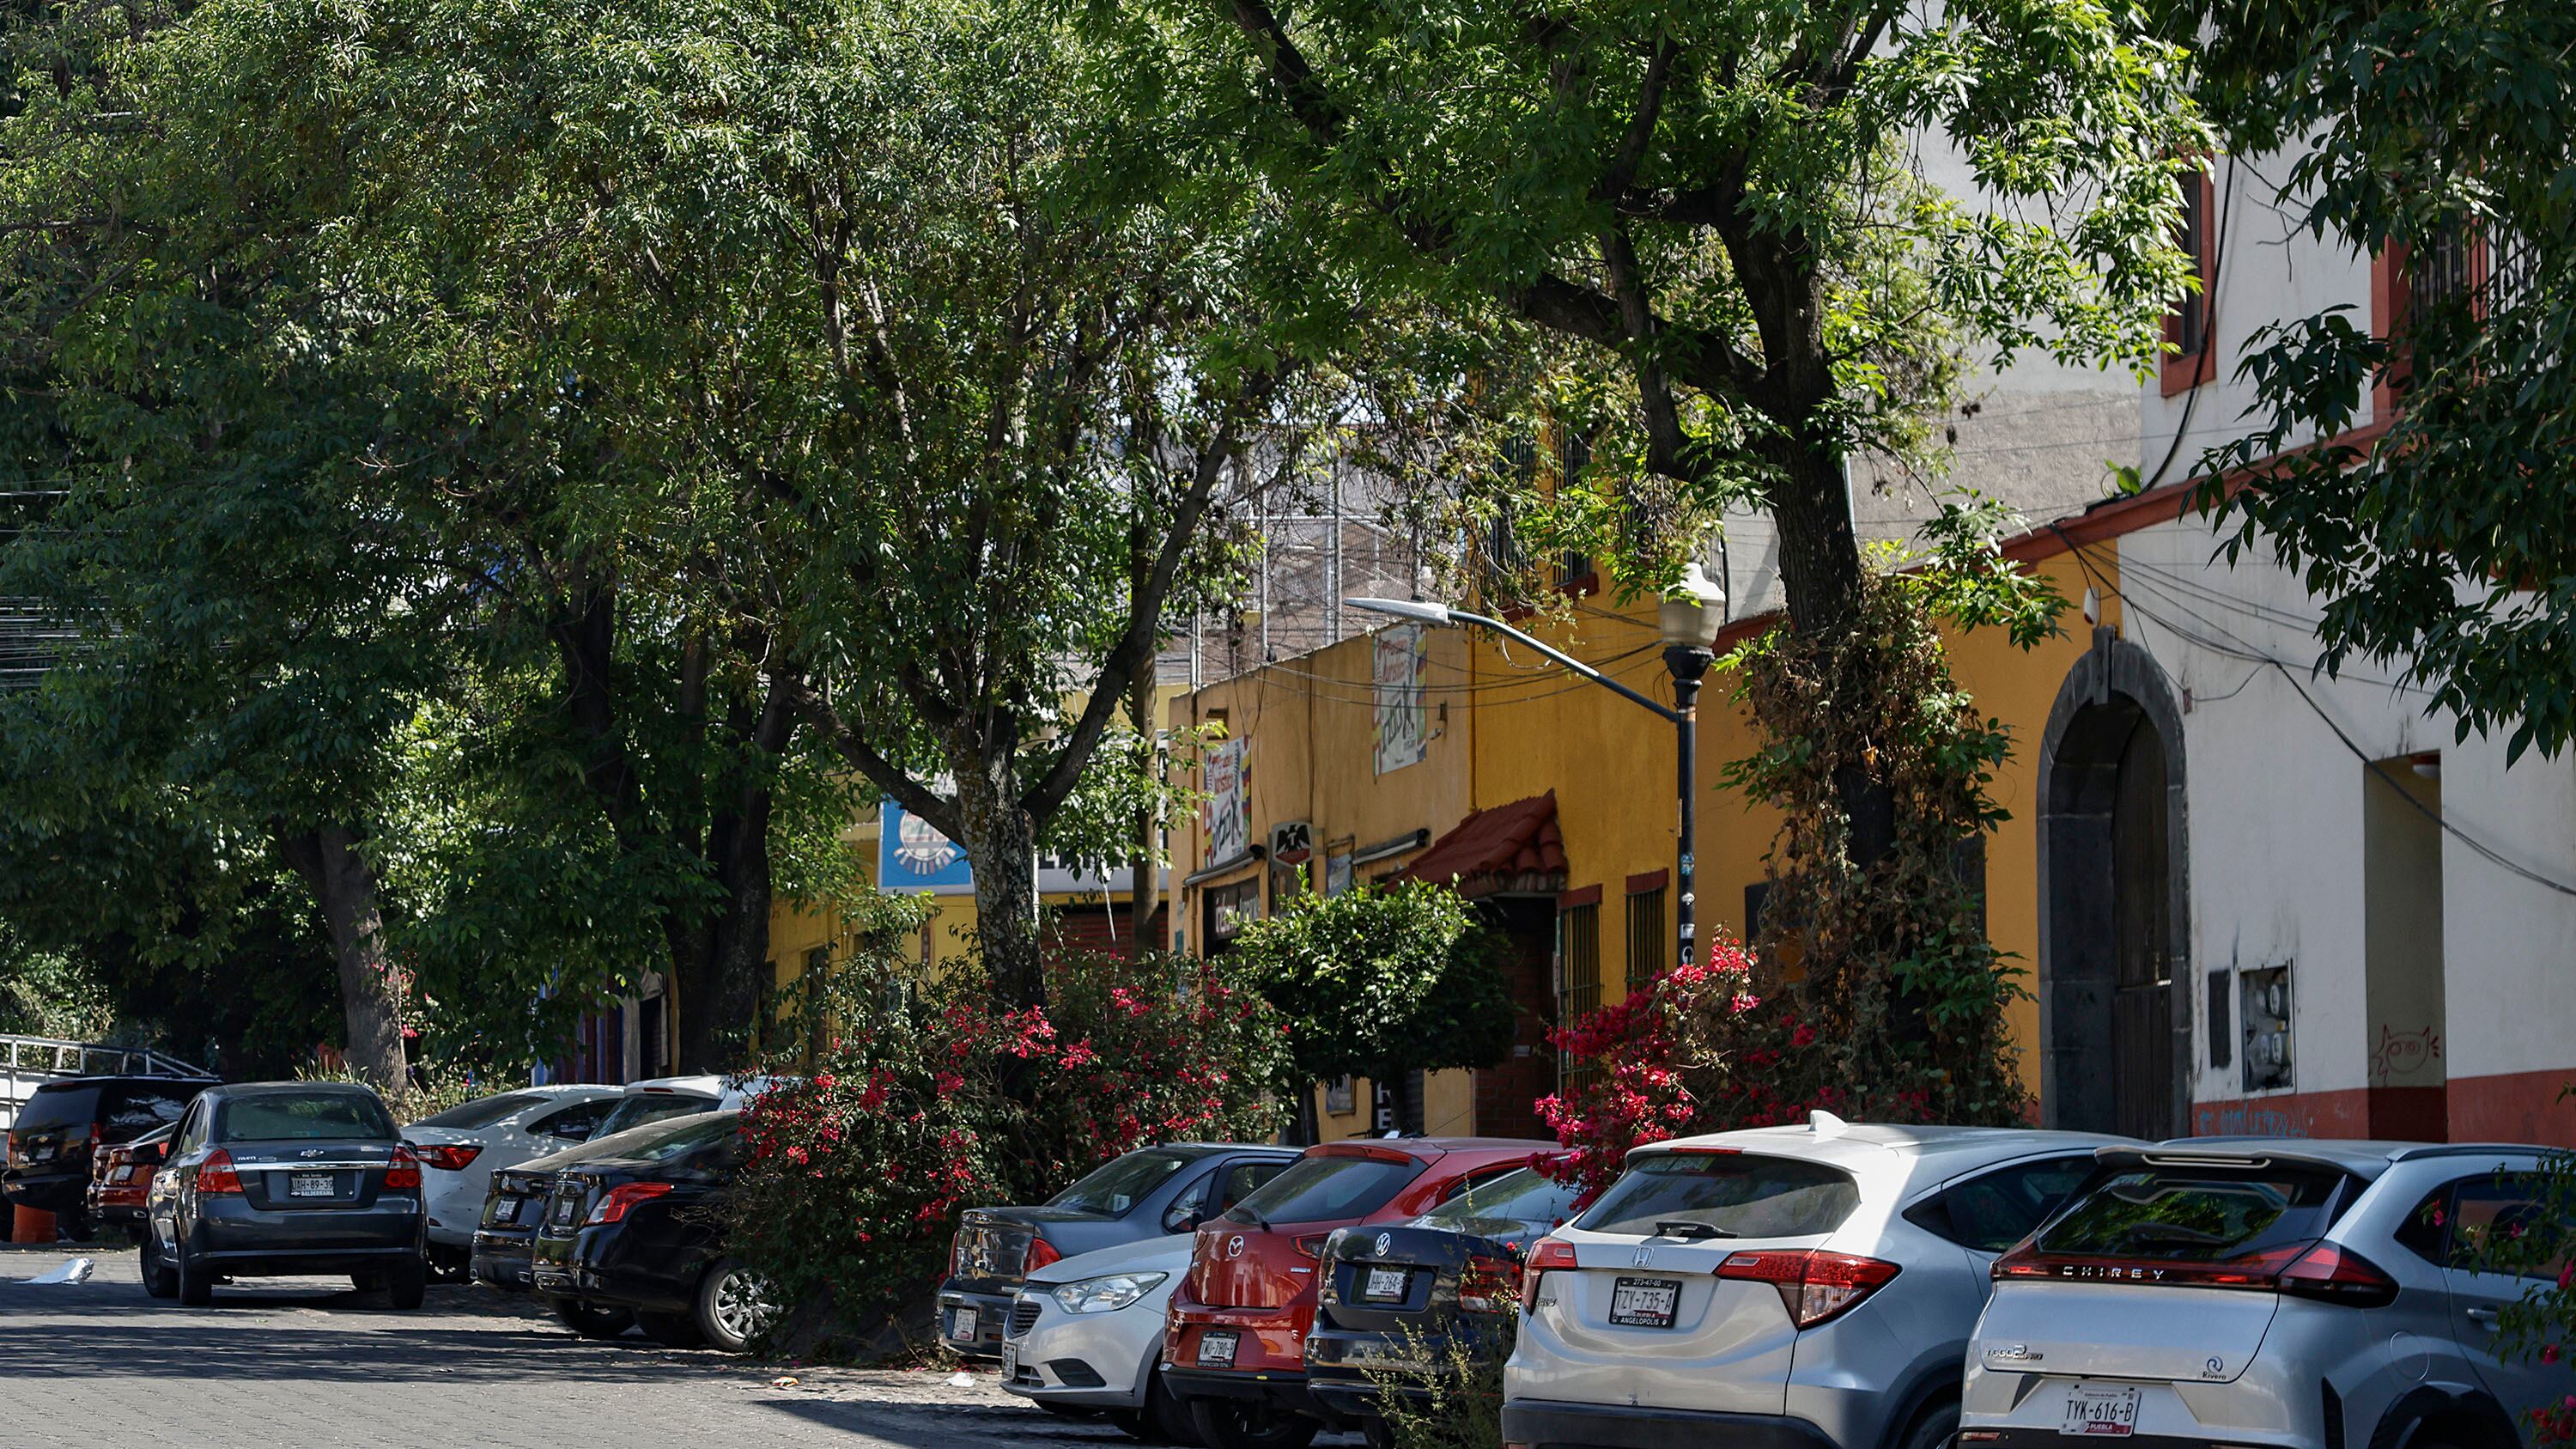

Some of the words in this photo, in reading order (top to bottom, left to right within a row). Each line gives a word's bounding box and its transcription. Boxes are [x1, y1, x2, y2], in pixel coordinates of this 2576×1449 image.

[2062, 1265, 2165, 1281] CHIREY
[1616, 1289, 1674, 1312] TZY-735-A
[1619, 1317, 1660, 1326] ANGELOPOLIS
[2202, 1371, 2227, 1380] Rivera
[2066, 1399, 2135, 1422] TYK-616-B
